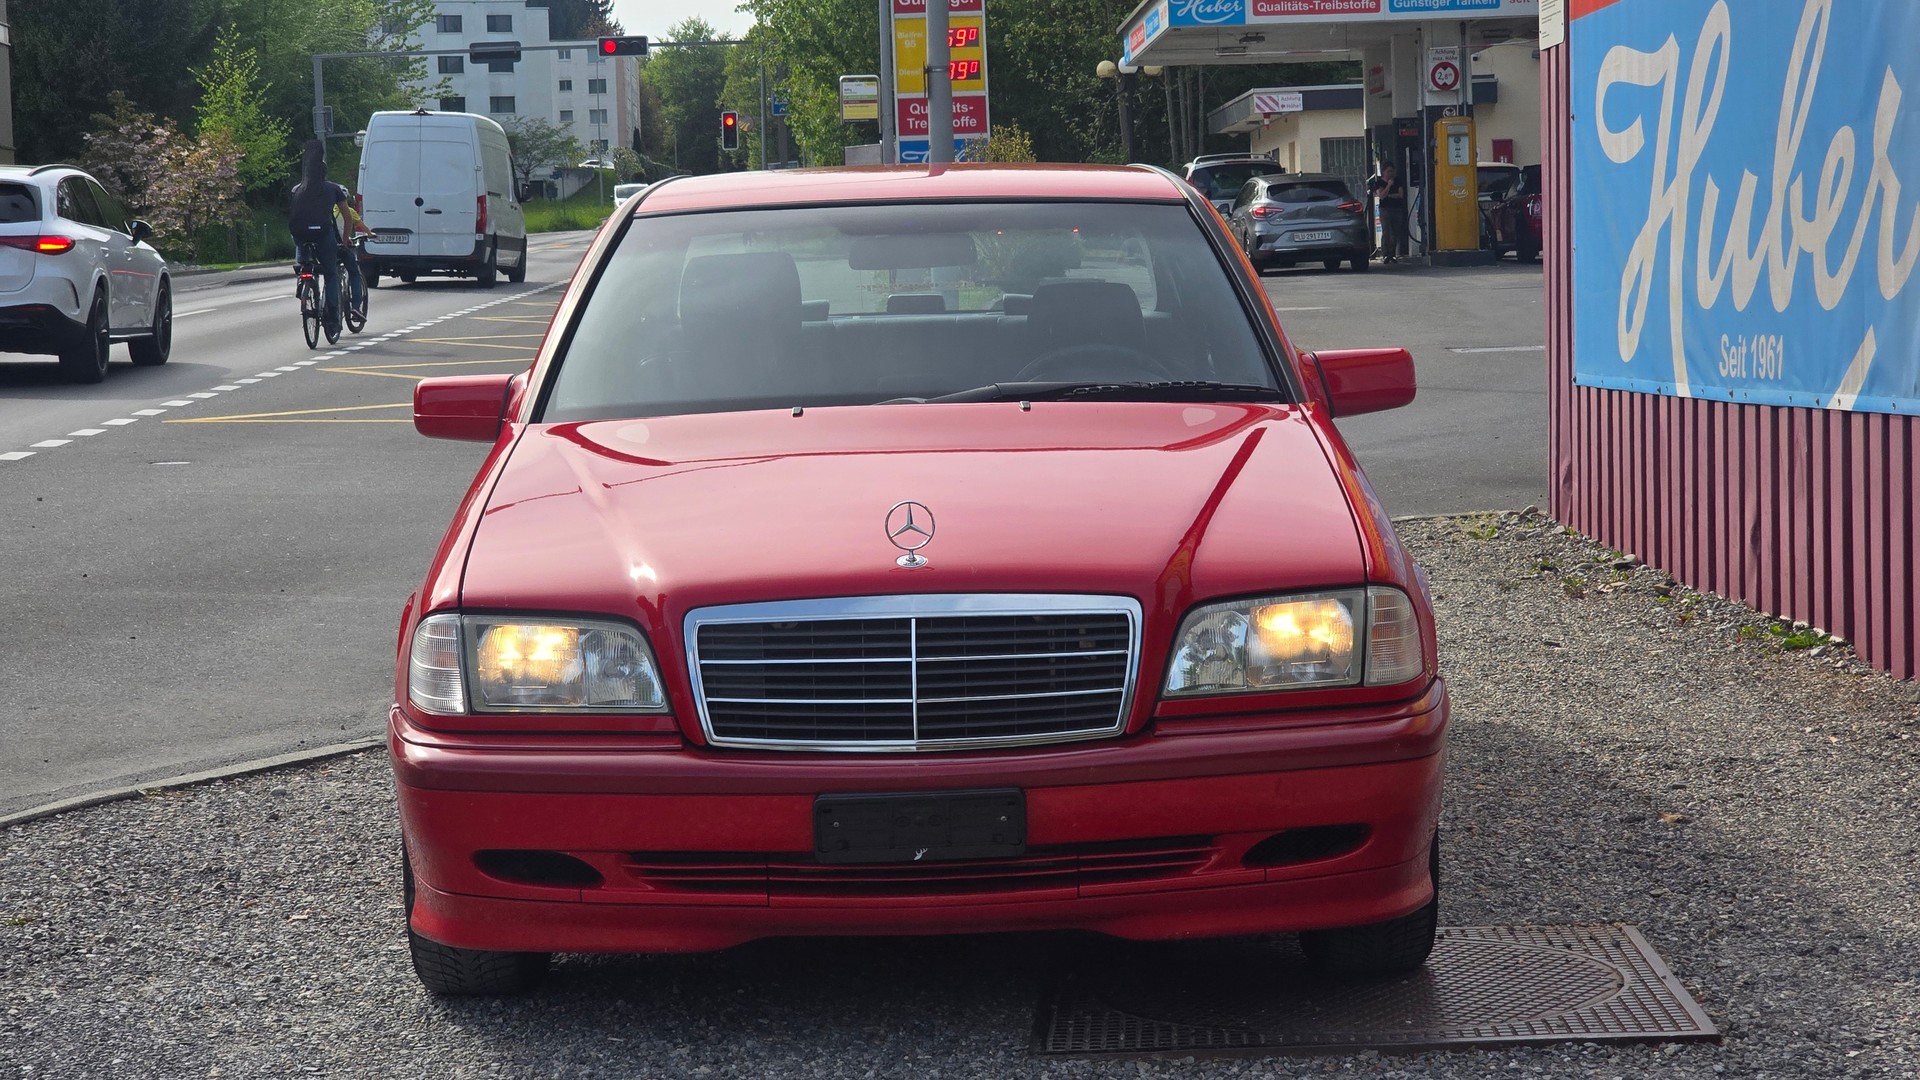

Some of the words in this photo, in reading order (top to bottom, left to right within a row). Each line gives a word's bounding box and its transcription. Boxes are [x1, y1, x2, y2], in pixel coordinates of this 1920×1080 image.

[1170, 0, 1243, 24] Huber
[1257, 0, 1377, 12] Qualitäts-Treibstoffe
[907, 116, 977, 130] Treoffe
[1595, 0, 1920, 400] Huber
[1719, 333, 1747, 379] Seit
[1751, 334, 1783, 380] 1961
